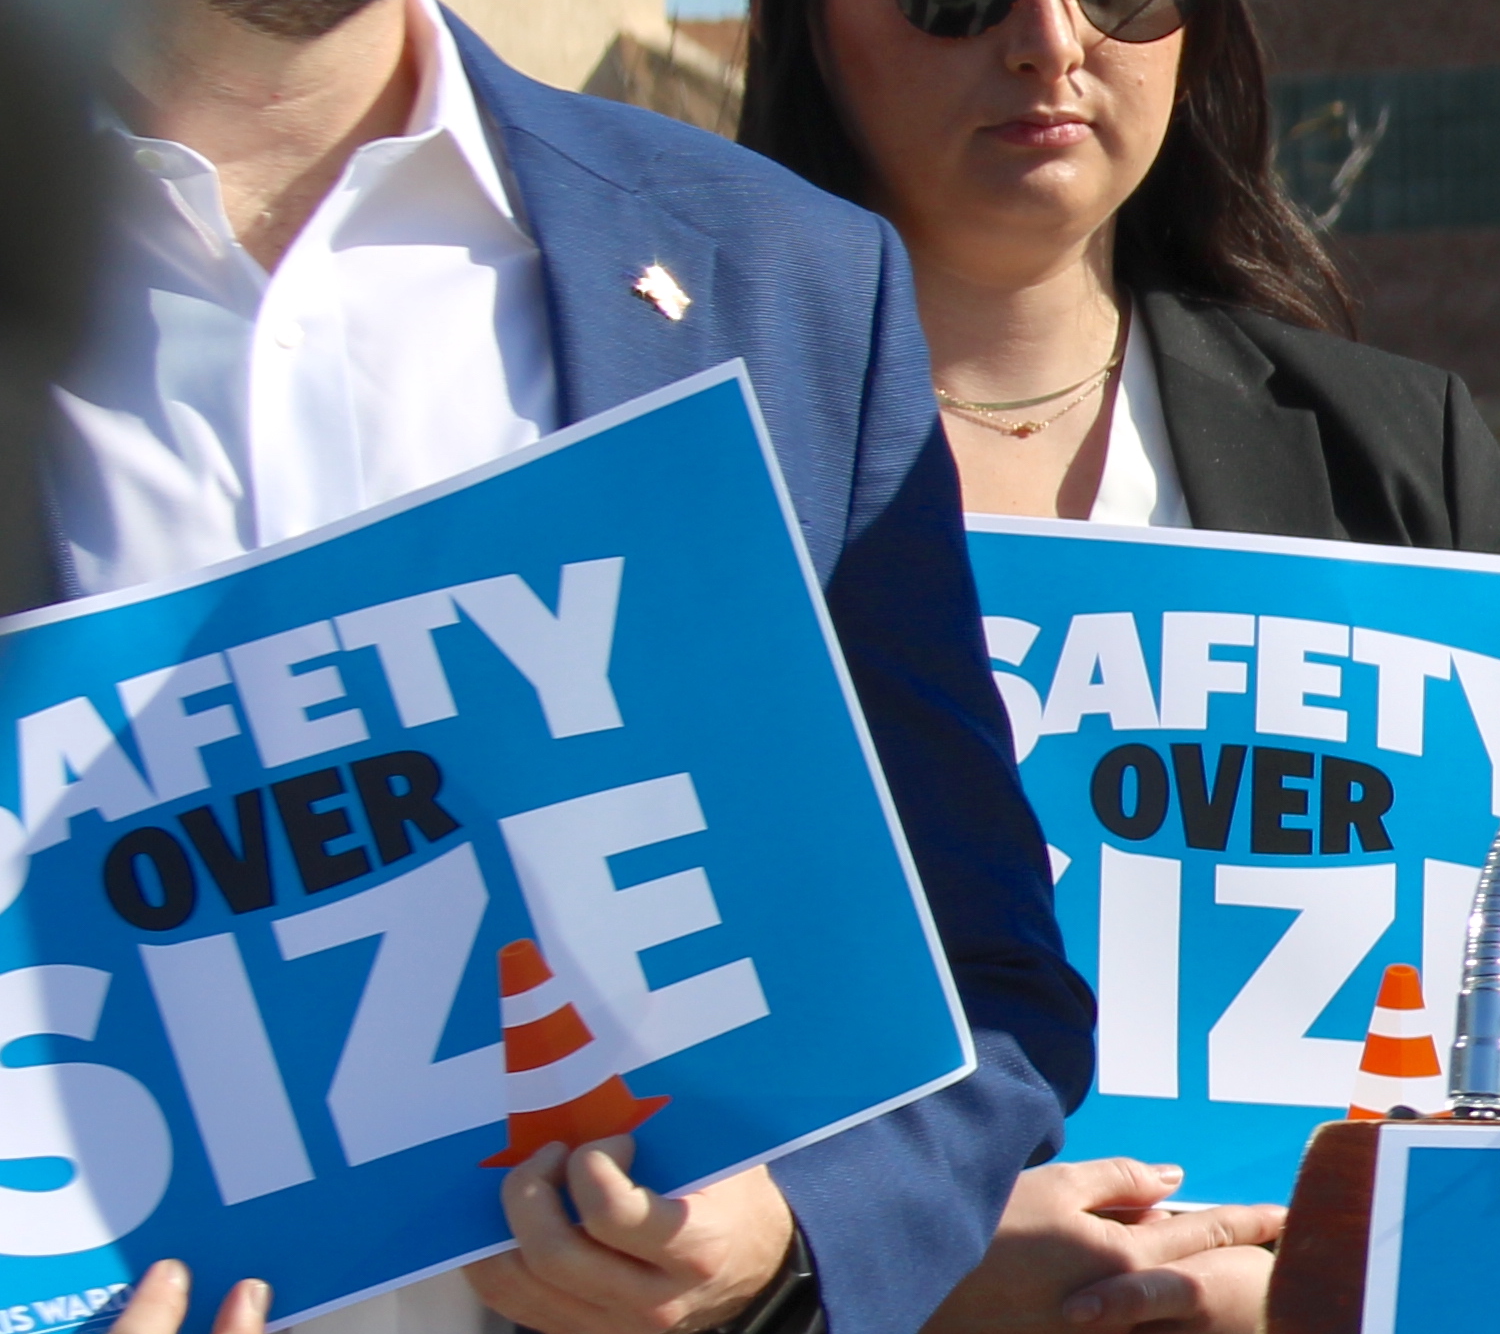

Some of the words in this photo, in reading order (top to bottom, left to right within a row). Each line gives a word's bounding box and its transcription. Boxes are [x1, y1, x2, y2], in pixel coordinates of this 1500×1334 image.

[0, 556, 625, 917] AFETY
[1090, 743, 1396, 856] OVER
[102, 749, 461, 931] OVER
